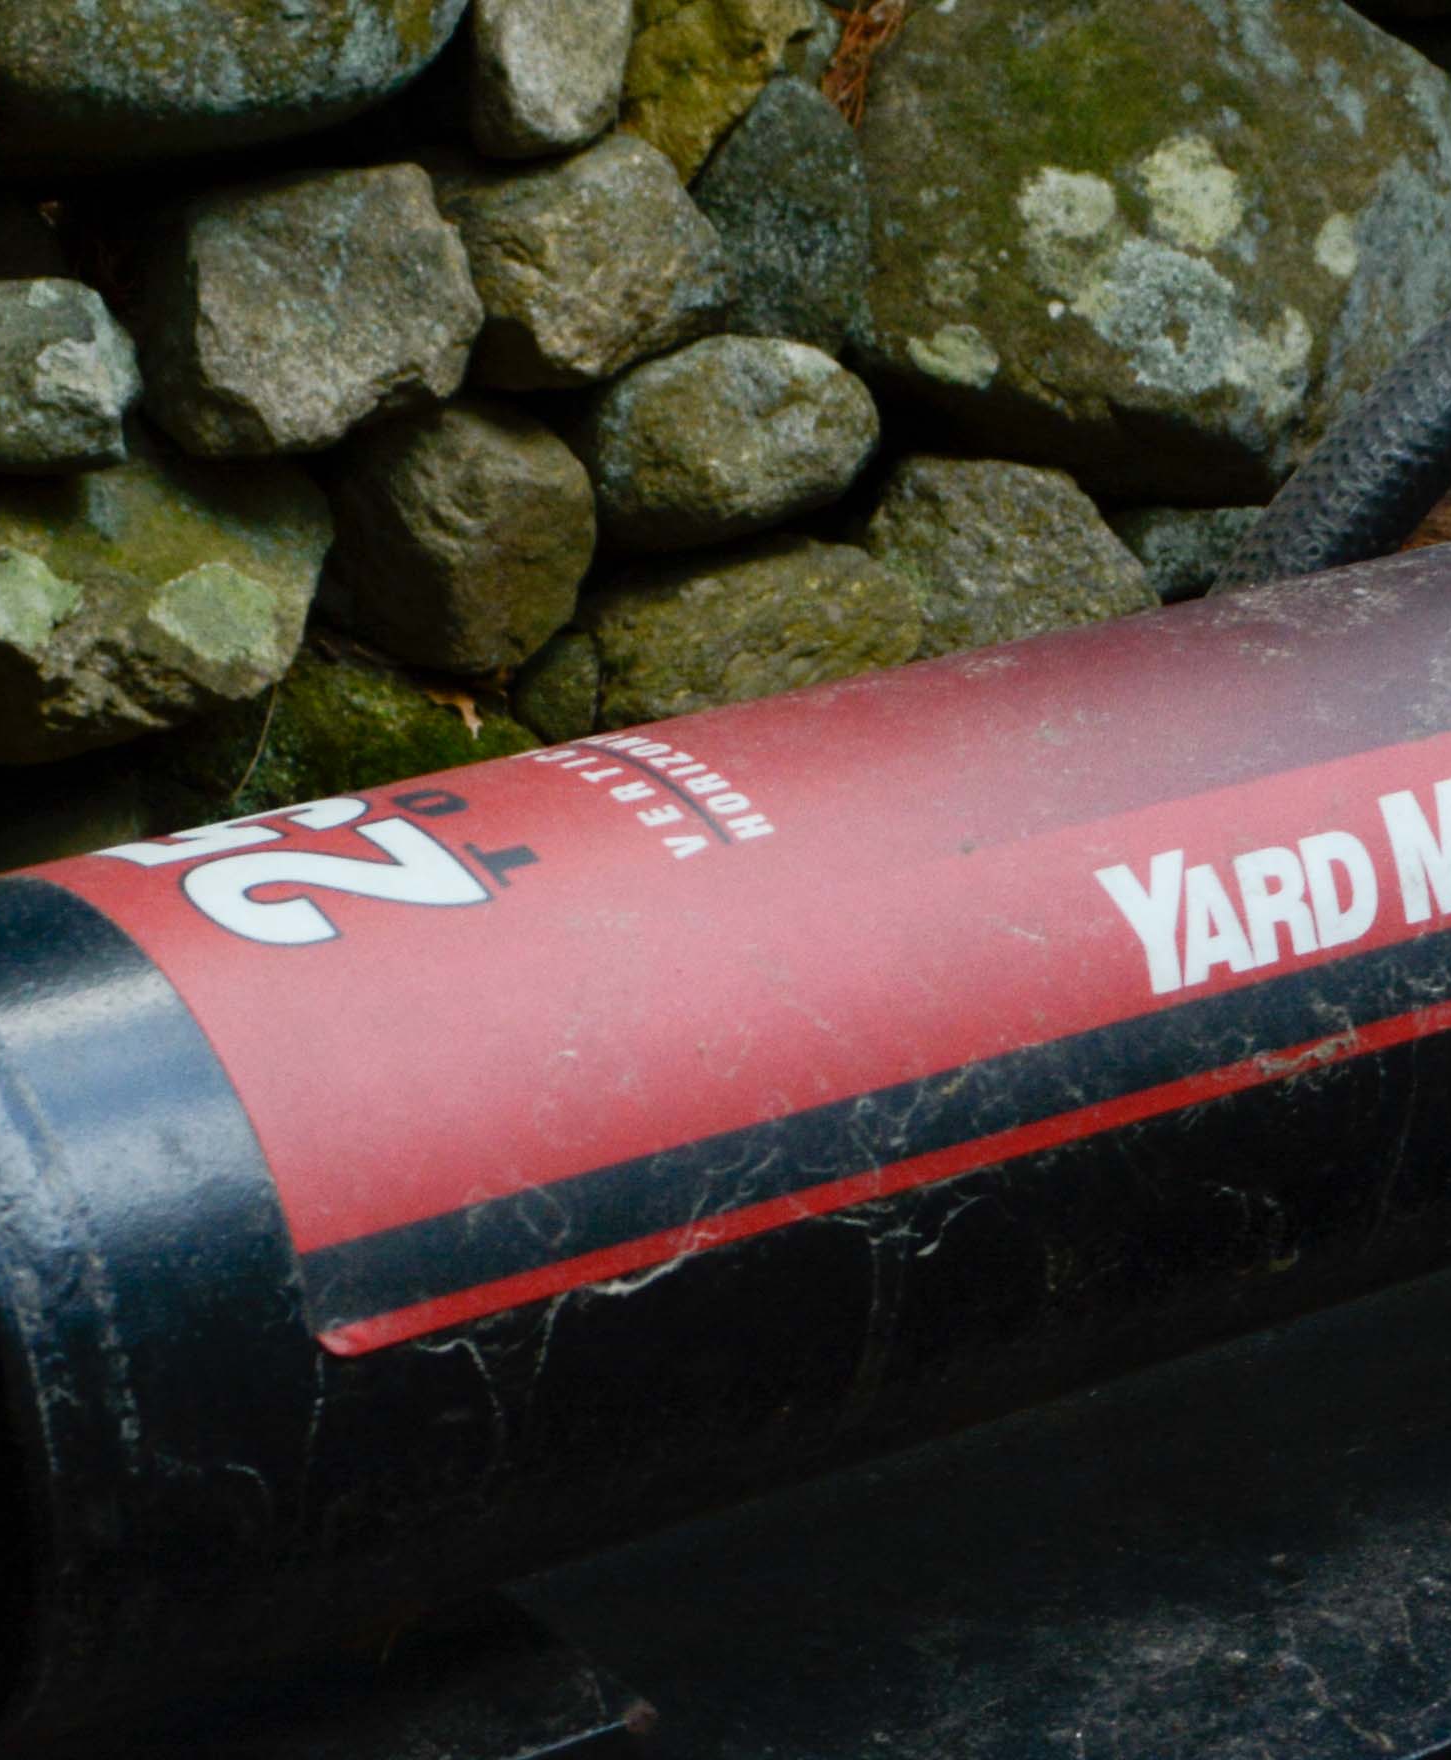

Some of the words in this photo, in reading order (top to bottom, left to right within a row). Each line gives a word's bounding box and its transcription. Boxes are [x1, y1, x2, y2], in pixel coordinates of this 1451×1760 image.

[391, 789, 540, 888] TO
[510, 748, 709, 859] VERTIC
[568, 734, 775, 840] HORIZONT
[1094, 830, 1378, 997] YARD
